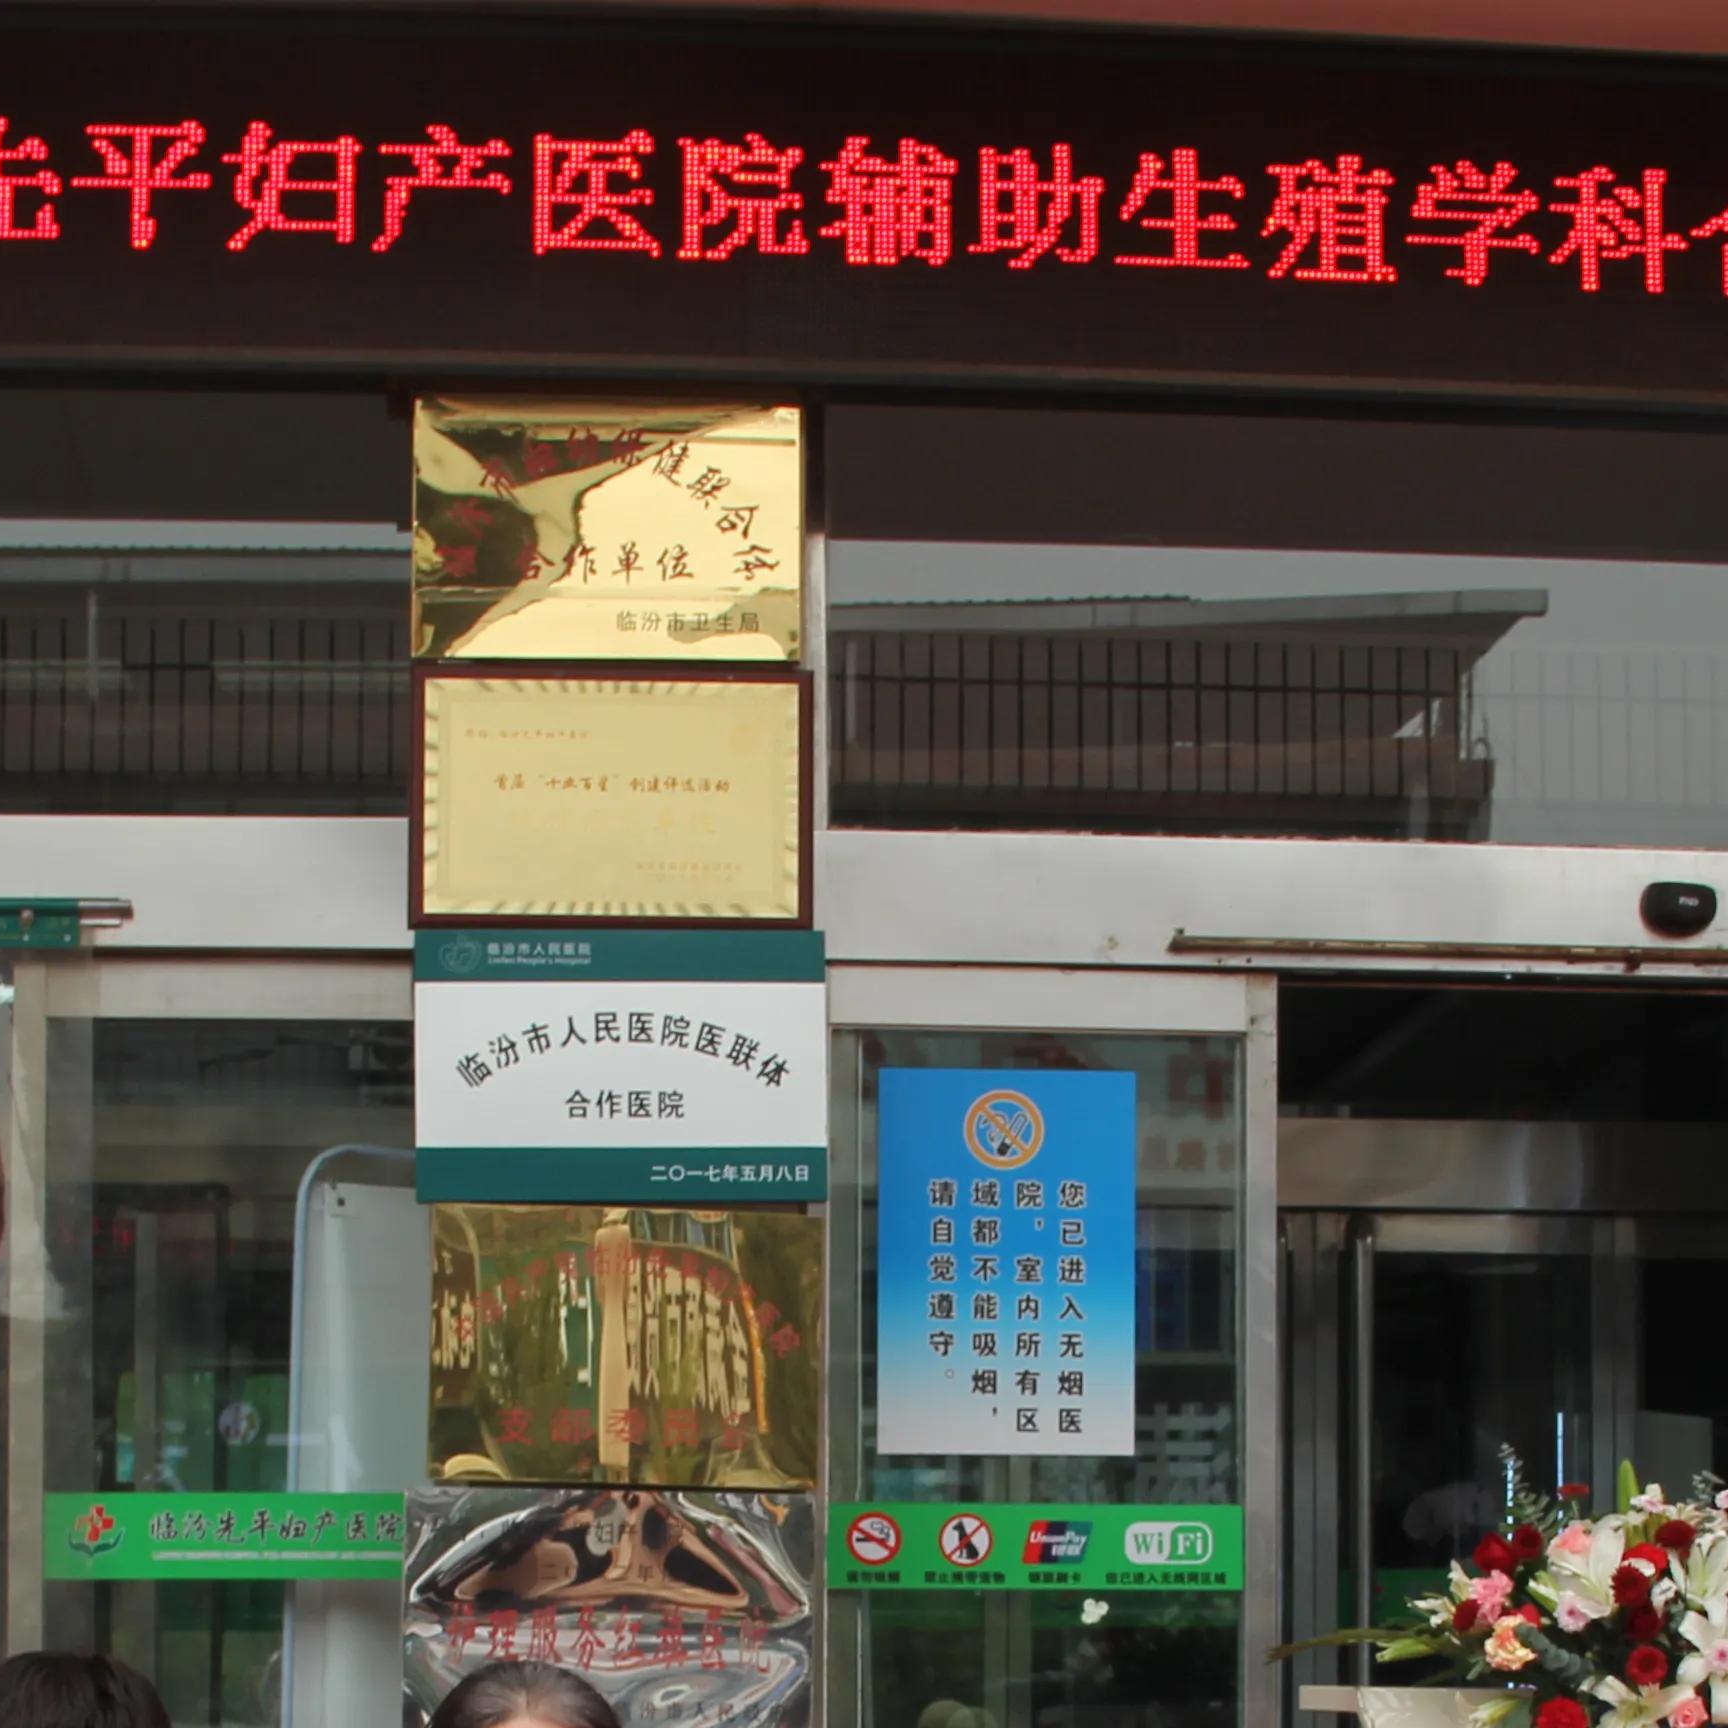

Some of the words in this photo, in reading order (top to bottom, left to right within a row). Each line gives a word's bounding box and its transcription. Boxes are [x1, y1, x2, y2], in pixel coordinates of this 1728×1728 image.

[524, 543, 695, 585] 合作单位
[617, 611, 760, 634] 临汾市卫生局
[456, 1011, 791, 1089] 临汾市人民医院医联体
[565, 1089, 686, 1120] 合作医院
[1058, 1180, 1088, 1434] 您已进入无烟医
[149, 1508, 404, 1547] 临汾先平妇产医院
[1029, 1529, 1088, 1547] UnionPay
